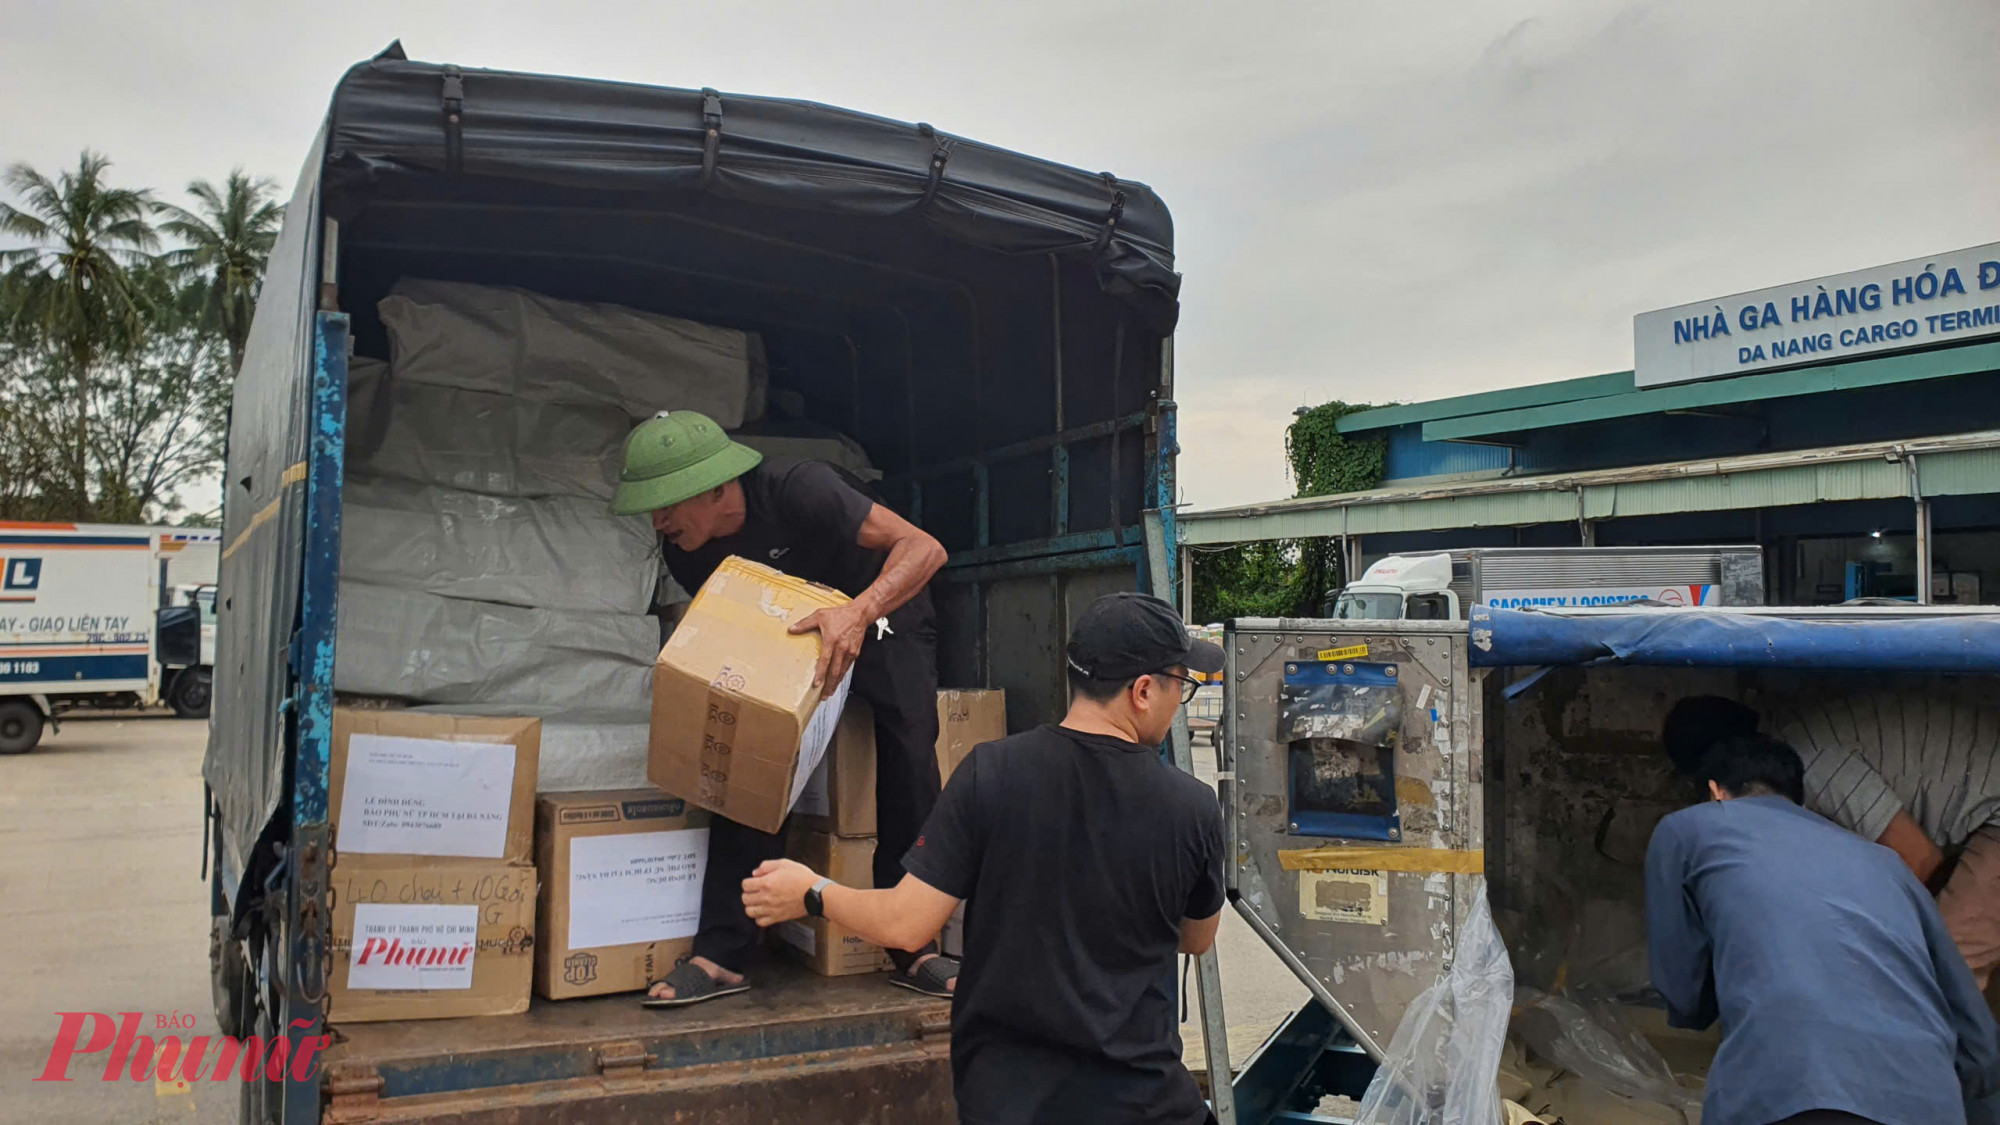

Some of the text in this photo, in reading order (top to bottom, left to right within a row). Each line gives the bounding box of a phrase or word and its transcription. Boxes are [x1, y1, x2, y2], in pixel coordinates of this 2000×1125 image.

[1673, 305, 1731, 345] NHÀ
[1738, 301, 1781, 332] GA
[1791, 285, 1882, 323] HÀNG
[1892, 263, 1967, 306] HÓA
[1738, 304, 2000, 365] DA NANG CARGO TERMI
[29, 615, 65, 633] GIAO
[104, 615, 129, 632] TAY
